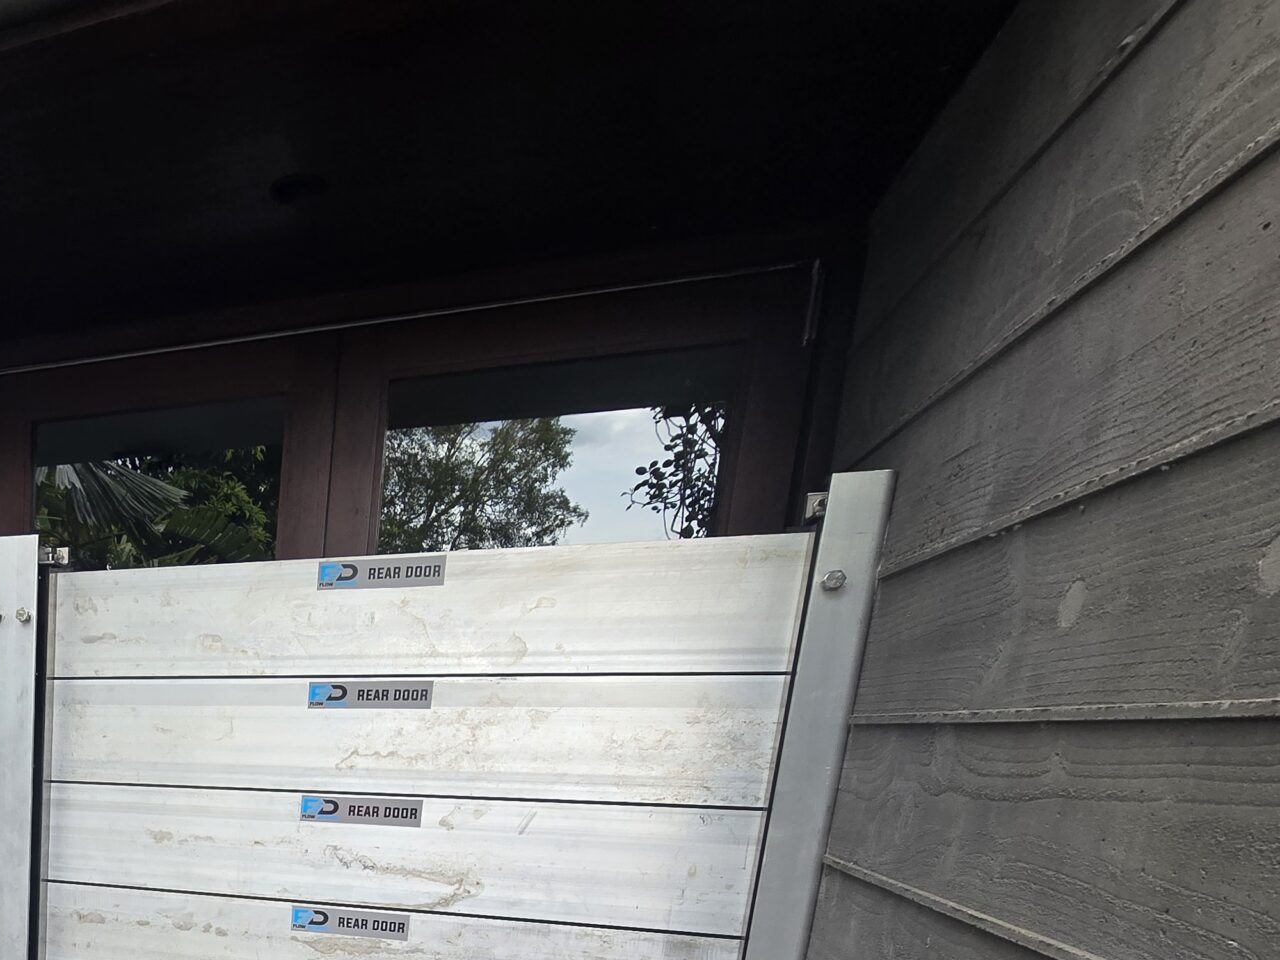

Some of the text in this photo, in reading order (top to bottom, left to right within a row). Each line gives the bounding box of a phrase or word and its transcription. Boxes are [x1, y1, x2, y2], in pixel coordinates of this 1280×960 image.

[368, 565, 441, 580] REAR DOOR
[357, 689, 428, 701] REAR DOOR
[348, 805, 379, 818] REAR
[384, 806, 418, 819] DOOR
[338, 917, 368, 930] REAR
[373, 920, 405, 933] DOOR
